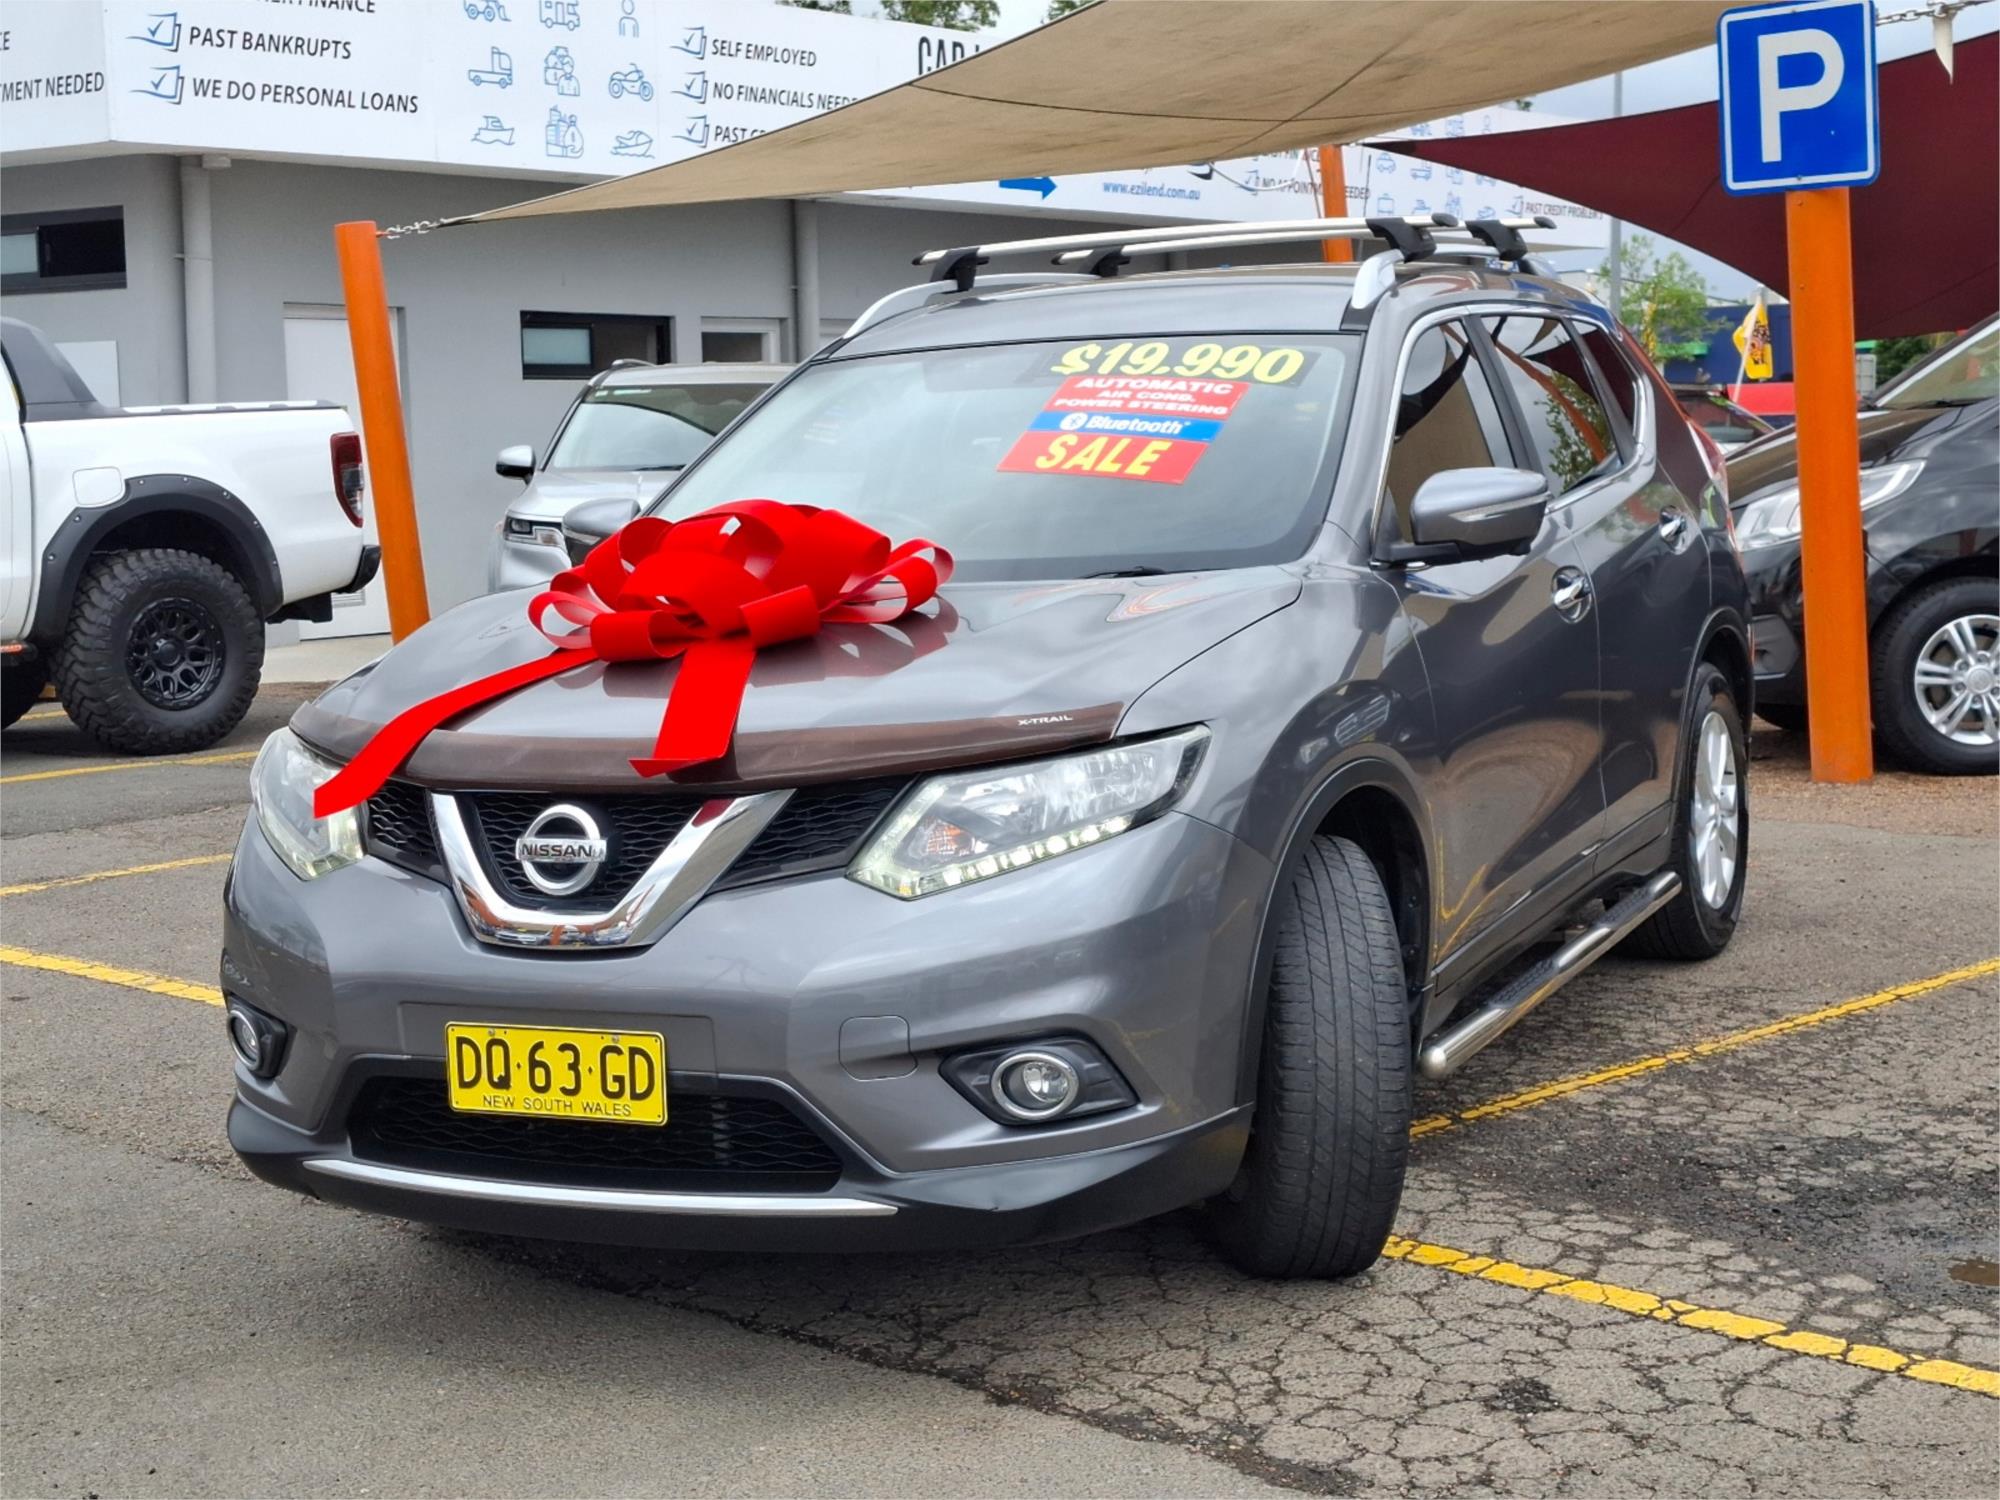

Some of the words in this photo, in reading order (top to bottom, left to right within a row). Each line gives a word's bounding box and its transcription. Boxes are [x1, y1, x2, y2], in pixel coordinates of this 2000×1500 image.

[189, 26, 237, 48] PAST
[242, 31, 351, 59] BANKRUPTS
[712, 39, 742, 57] SELF
[745, 43, 817, 67] EMPLOYED
[0, 79, 42, 102] MENT
[46, 71, 104, 97] NEEDED
[193, 78, 222, 98] WE
[227, 81, 256, 101] DO
[261, 84, 355, 108] PERSONAL
[360, 91, 418, 113] LOANS
[713, 82, 734, 100] NO
[737, 85, 814, 108] FINANCIALS
[1758, 29, 1845, 163] P
[714, 125, 747, 143] PAST
[1103, 182, 1200, 200] www.ezilend.com.au
[1543, 203, 1567, 216] CREDIT
[1075, 377, 1234, 394] AUTOMATIC
[1054, 398, 1124, 408] POWER
[1128, 400, 1229, 415] STEERING
[1098, 391, 1132, 399] AIR
[1136, 391, 1197, 402] COND.
[1085, 414, 1184, 434] Bluetooth
[1035, 434, 1174, 476] SALE
[1018, 715, 1073, 726] X-TRAIL
[521, 843, 593, 857] NISSAN
[483, 1095, 515, 1108] NEW
[523, 1098, 572, 1113] SOUTH
[582, 1101, 631, 1116] WALES
